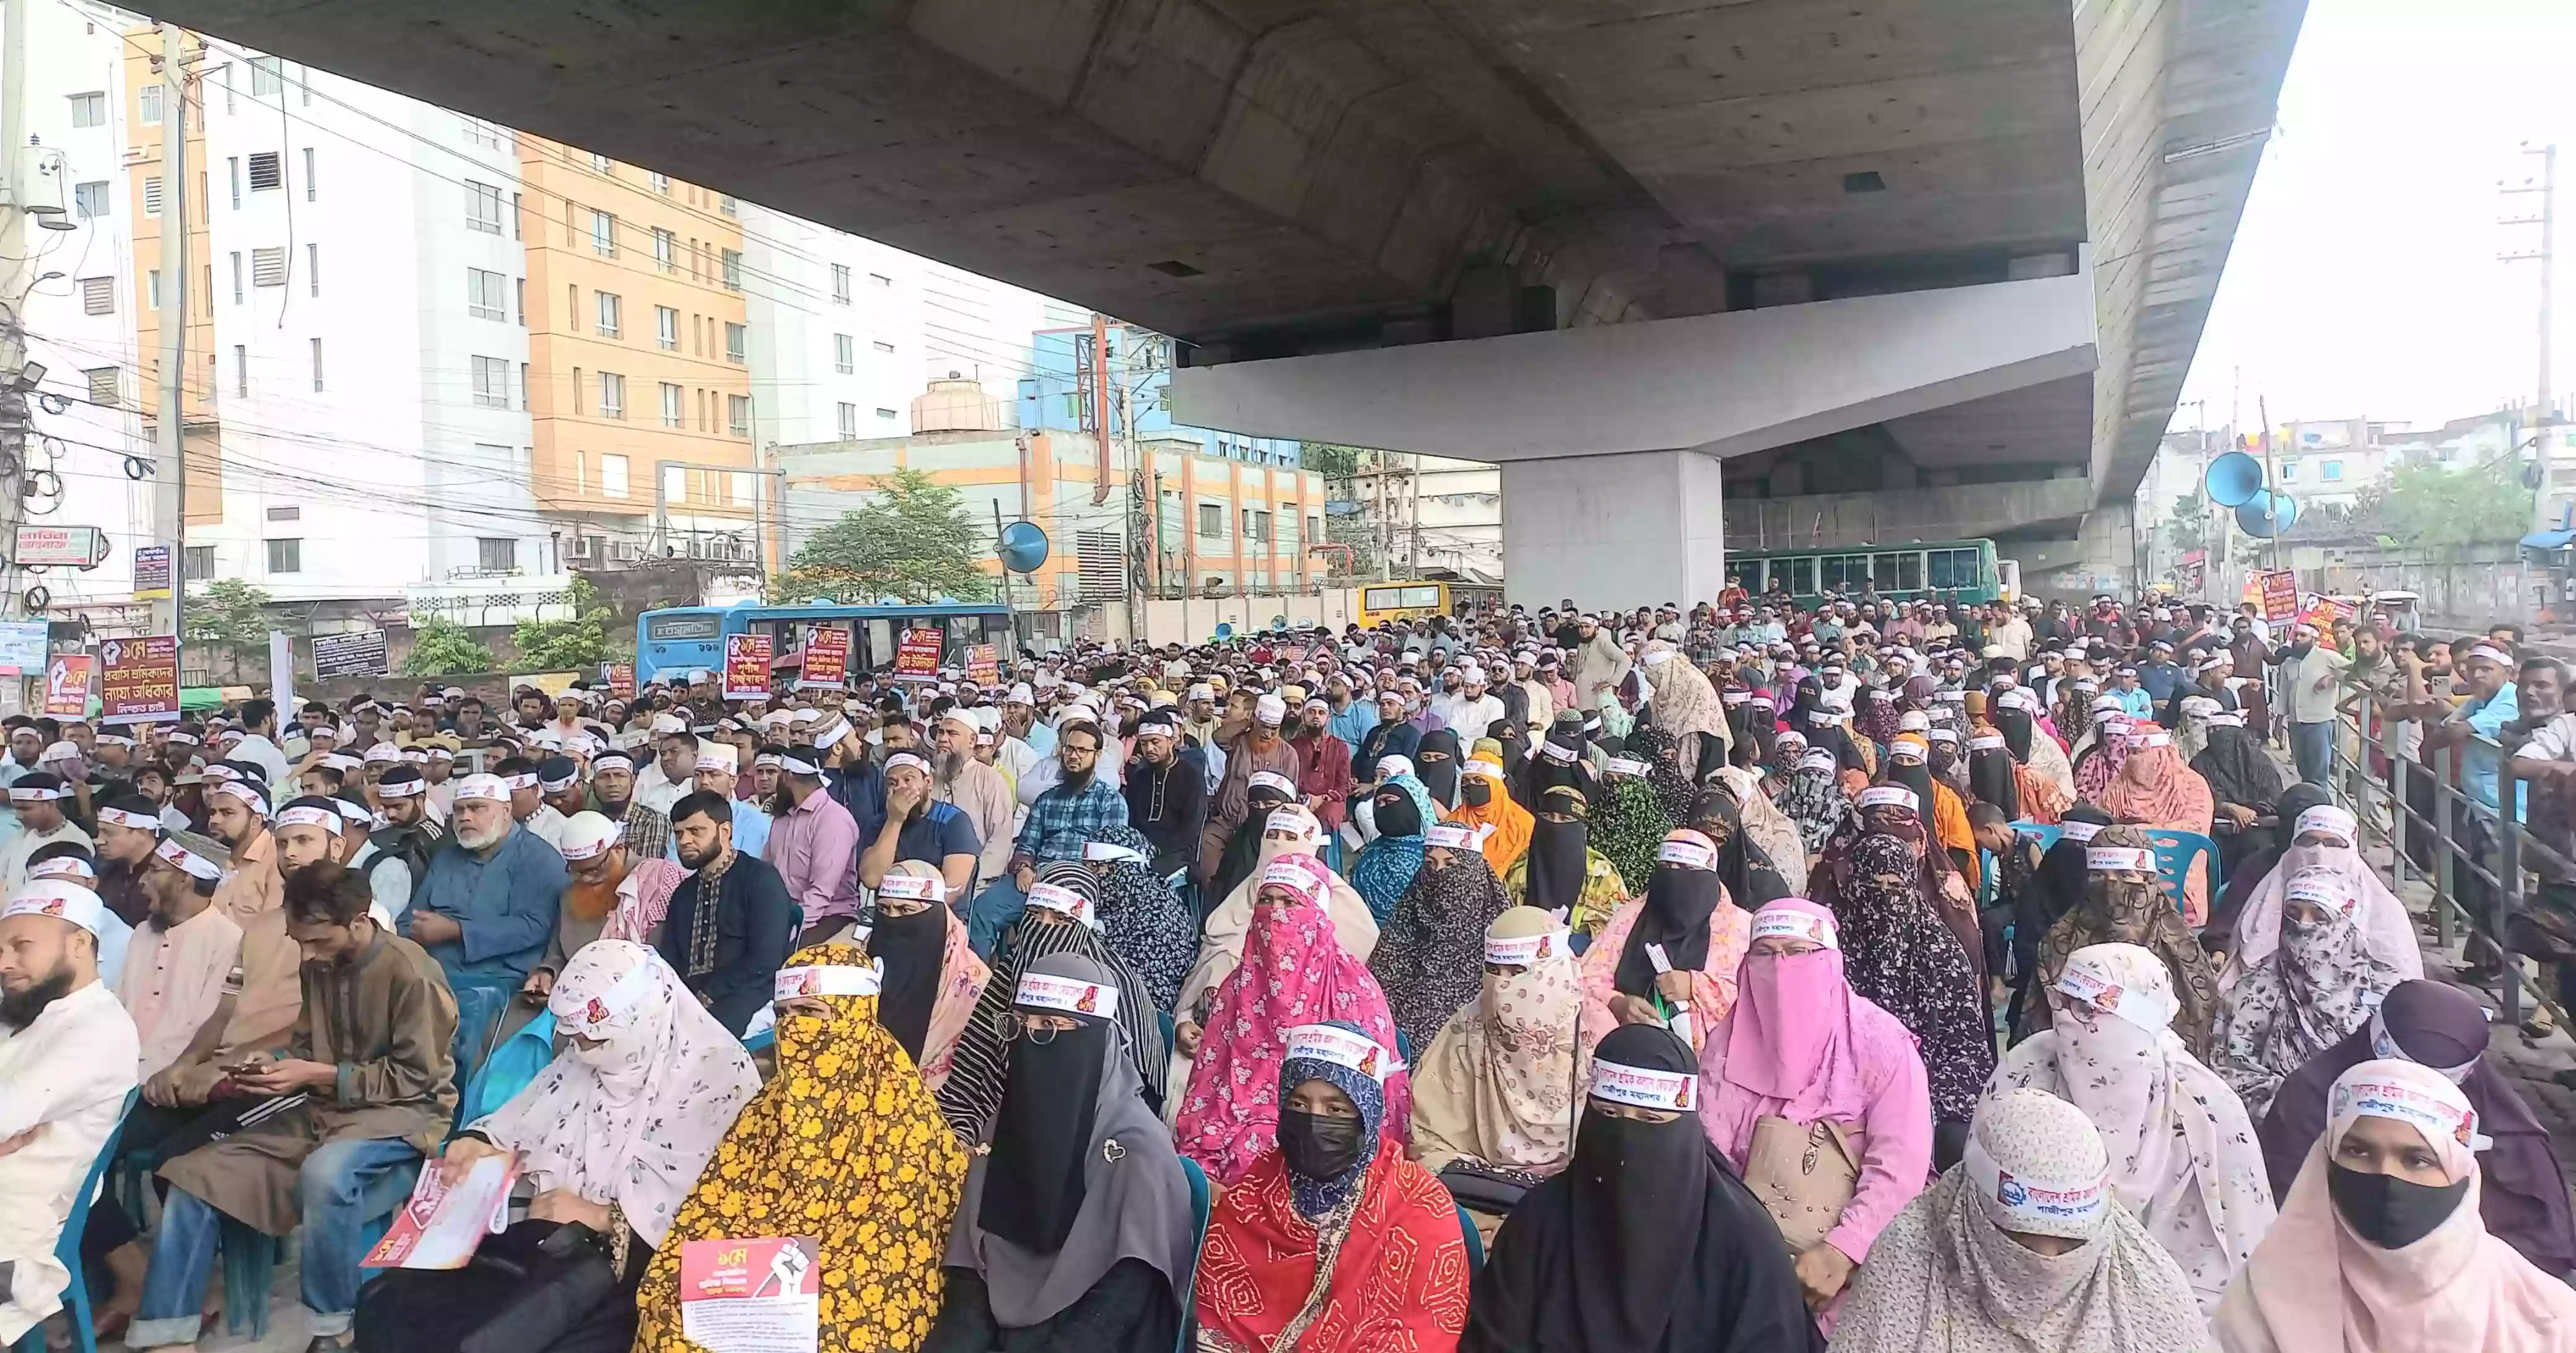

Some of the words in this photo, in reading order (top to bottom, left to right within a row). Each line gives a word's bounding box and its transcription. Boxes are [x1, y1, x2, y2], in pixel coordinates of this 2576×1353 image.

[122, 640, 146, 660] ১মে
[131, 664, 173, 680] শ্রমিকদের
[132, 680, 173, 699] অধিকার
[148, 702, 166, 712] চাই
[2037, 1205, 2074, 1217] গাজীপুর
[717, 1248, 748, 1267] ১মে
